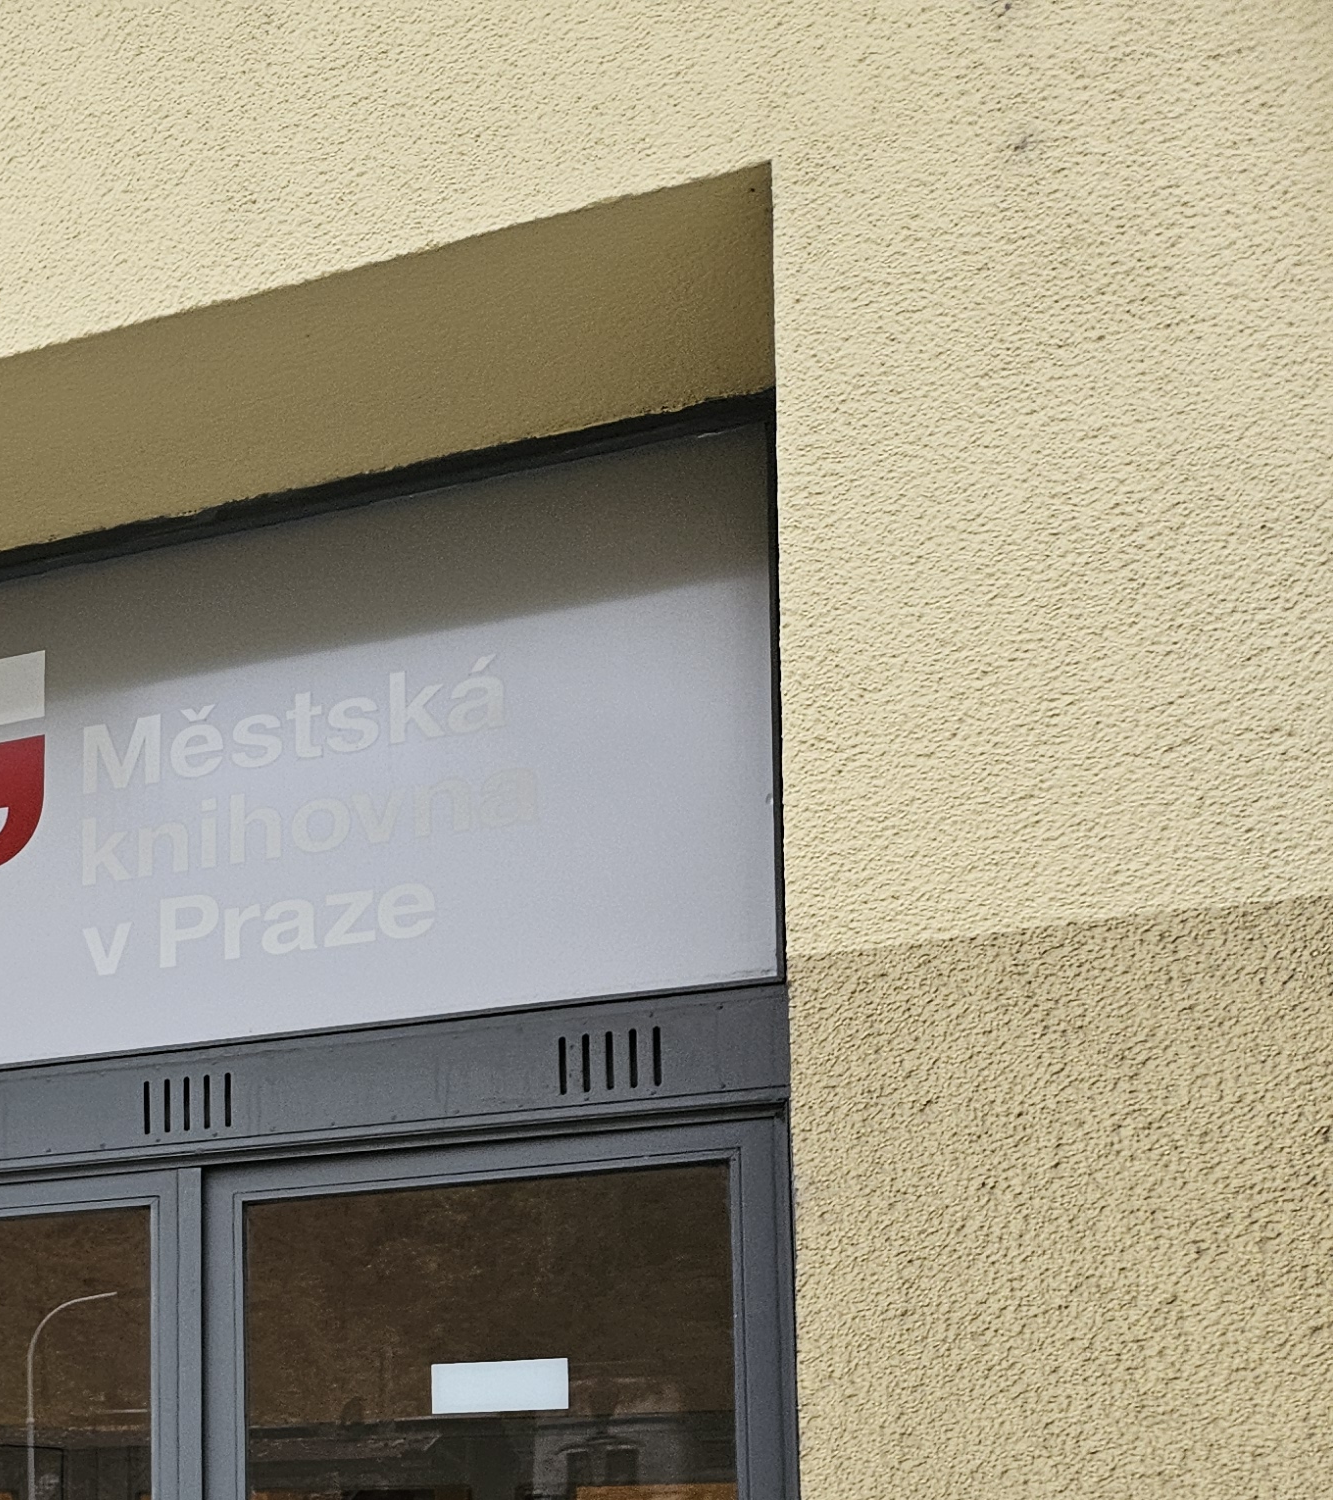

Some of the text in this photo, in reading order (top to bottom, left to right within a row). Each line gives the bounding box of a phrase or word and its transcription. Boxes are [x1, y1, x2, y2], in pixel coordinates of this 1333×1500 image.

[82, 653, 507, 794] Městská
[81, 767, 538, 886] knihovna
[82, 883, 435, 976] v Praze
